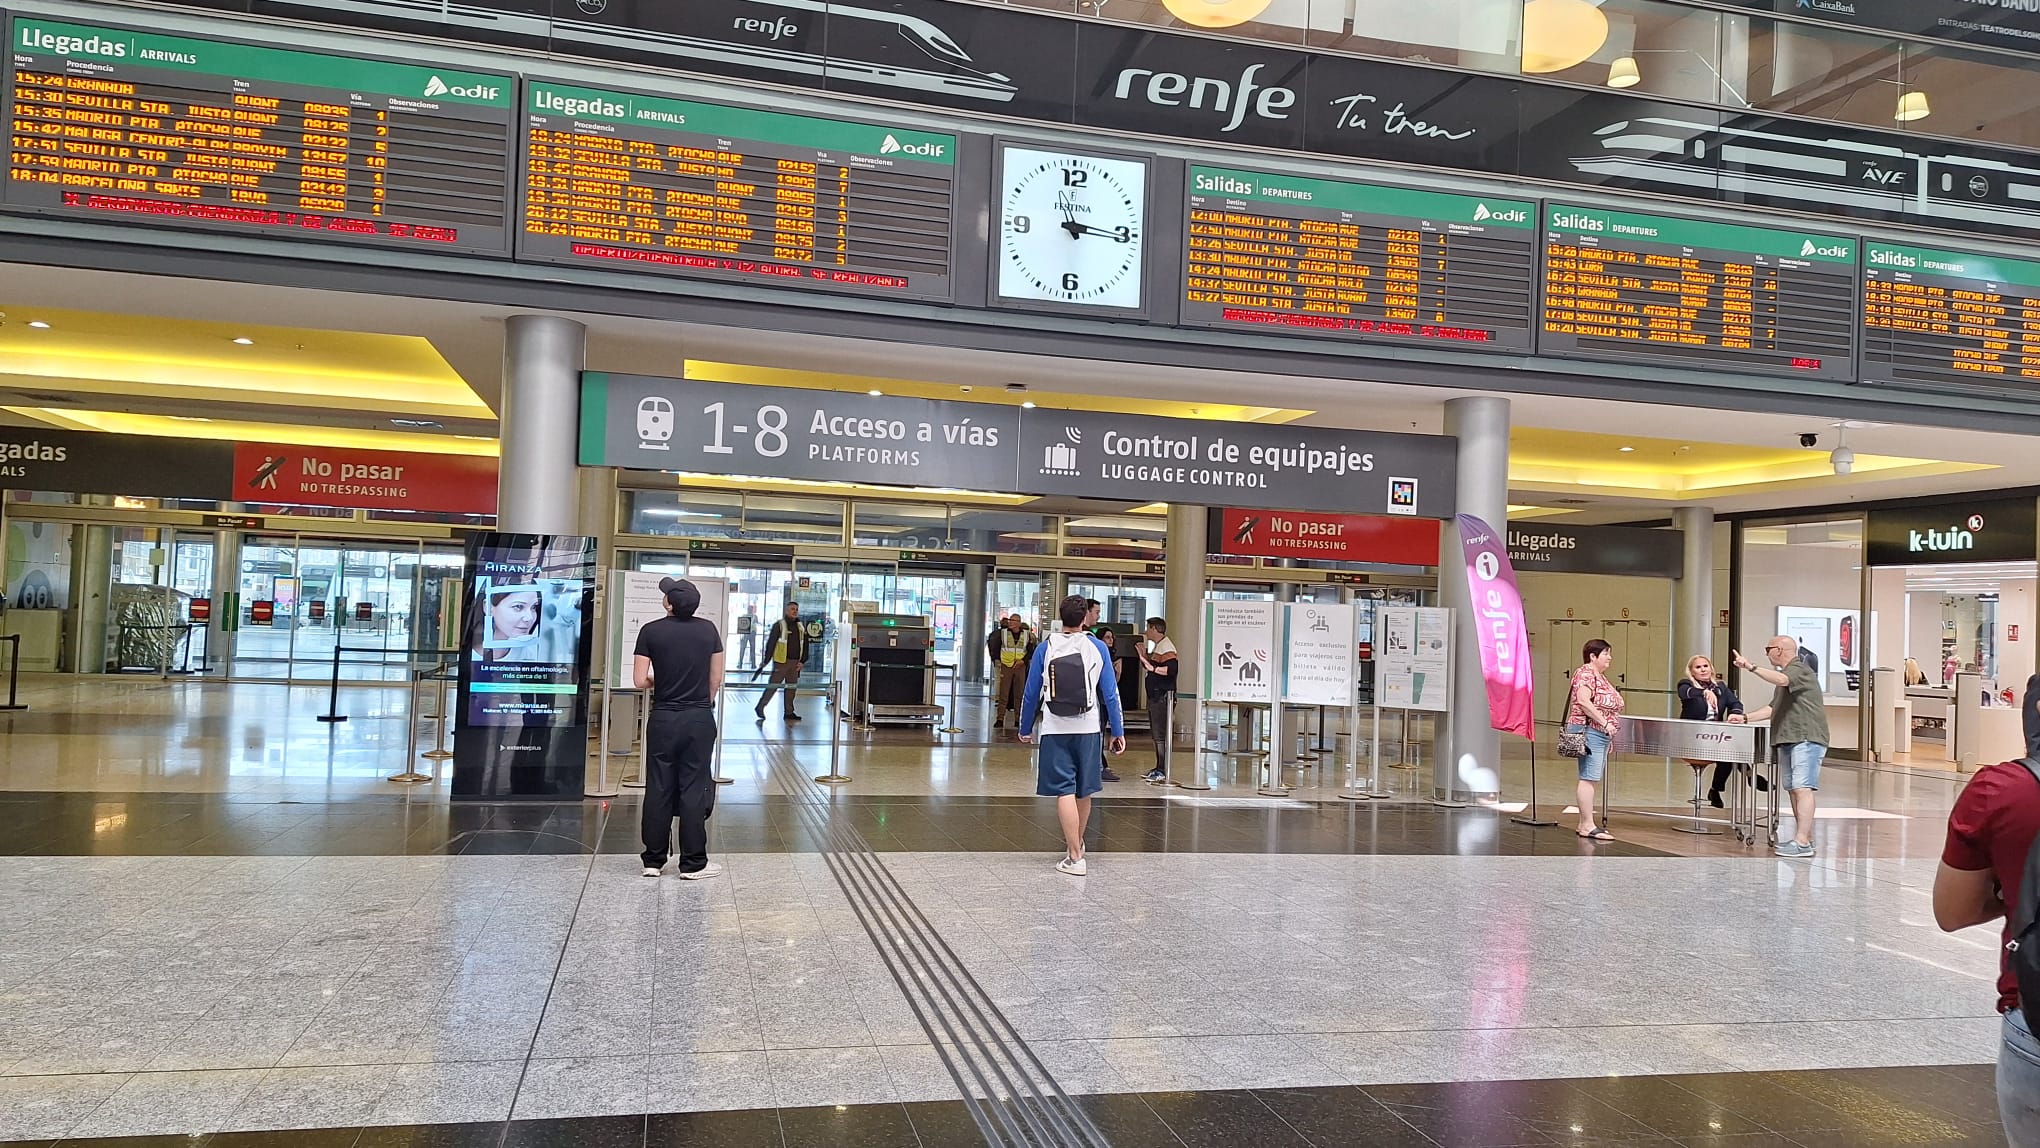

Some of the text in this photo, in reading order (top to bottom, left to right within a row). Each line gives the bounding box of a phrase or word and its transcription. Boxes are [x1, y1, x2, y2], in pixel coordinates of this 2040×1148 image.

[1811, 0, 1856, 14] CaixaBank
[2001, 0, 2040, 13] BAND
[733, 15, 798, 41] renfe
[22, 27, 197, 65] Llegadas ARRIVALS
[14, 54, 439, 110] Hora Procedencia Tren Vía Observaciones
[14, 88, 64, 102] 15:30
[65, 93, 133, 110] SEVILLA
[450, 85, 500, 100] adif
[535, 90, 685, 125] Llegadas ARRIVALS
[1114, 62, 1476, 141] renfe Tu tren
[14, 104, 63, 119] 15:35
[12, 136, 57, 150] 17:51
[530, 115, 547, 124] Hora
[574, 121, 615, 133] Procedencia
[717, 138, 732, 146] Tren
[850, 155, 893, 167] Observaciones
[902, 142, 945, 157] adif
[11, 152, 60, 167] 17:59
[10, 168, 59, 183] 18:04
[1060, 168, 1088, 188] 12
[1862, 168, 1908, 185] AVE
[1195, 174, 1313, 201] Salidas DEPARTURES
[525, 204, 569, 220] 20:12
[1054, 202, 1092, 214] FESTINA
[1013, 215, 1031, 234] 9
[1492, 210, 1528, 223] adif
[1553, 212, 1658, 236] Salidas DEPARTURES
[525, 220, 568, 235] 20:24
[1114, 226, 1131, 243] 3
[1189, 237, 1222, 249] 13:26
[1222, 240, 1269, 253] SEVILLA
[1817, 246, 1849, 258] adif
[1188, 250, 1221, 262] 13:30
[1870, 249, 1965, 273] Salidas DEPARTURES
[1188, 264, 1221, 276] 14:24
[1062, 273, 1079, 291] 6
[1187, 277, 1220, 289] 14:37
[1222, 280, 1268, 293] SEVILLA
[1187, 290, 1220, 302] 15:27
[1221, 293, 1267, 306] SEVILLA
[702, 401, 999, 458] 1-8 Acceso a vías
[808, 443, 921, 466] PLATFORMS
[1102, 430, 1374, 476] Control de equipajes
[0, 465, 26, 477] ALS
[301, 457, 404, 481] No pasar
[1101, 463, 1268, 489] LUGGAGE CONTROL
[300, 482, 408, 498] NO TRESPASSING
[1270, 517, 1345, 538] No pasar
[1269, 538, 1347, 551] NO TRESPASSING
[1466, 534, 1490, 545] renfe
[1508, 530, 1576, 550] Llegadas
[1909, 525, 1973, 552] k-tuin
[1508, 552, 1551, 562] ARRIVALS
[1482, 589, 1513, 674] renfe
[1695, 731, 1732, 744] renfe
